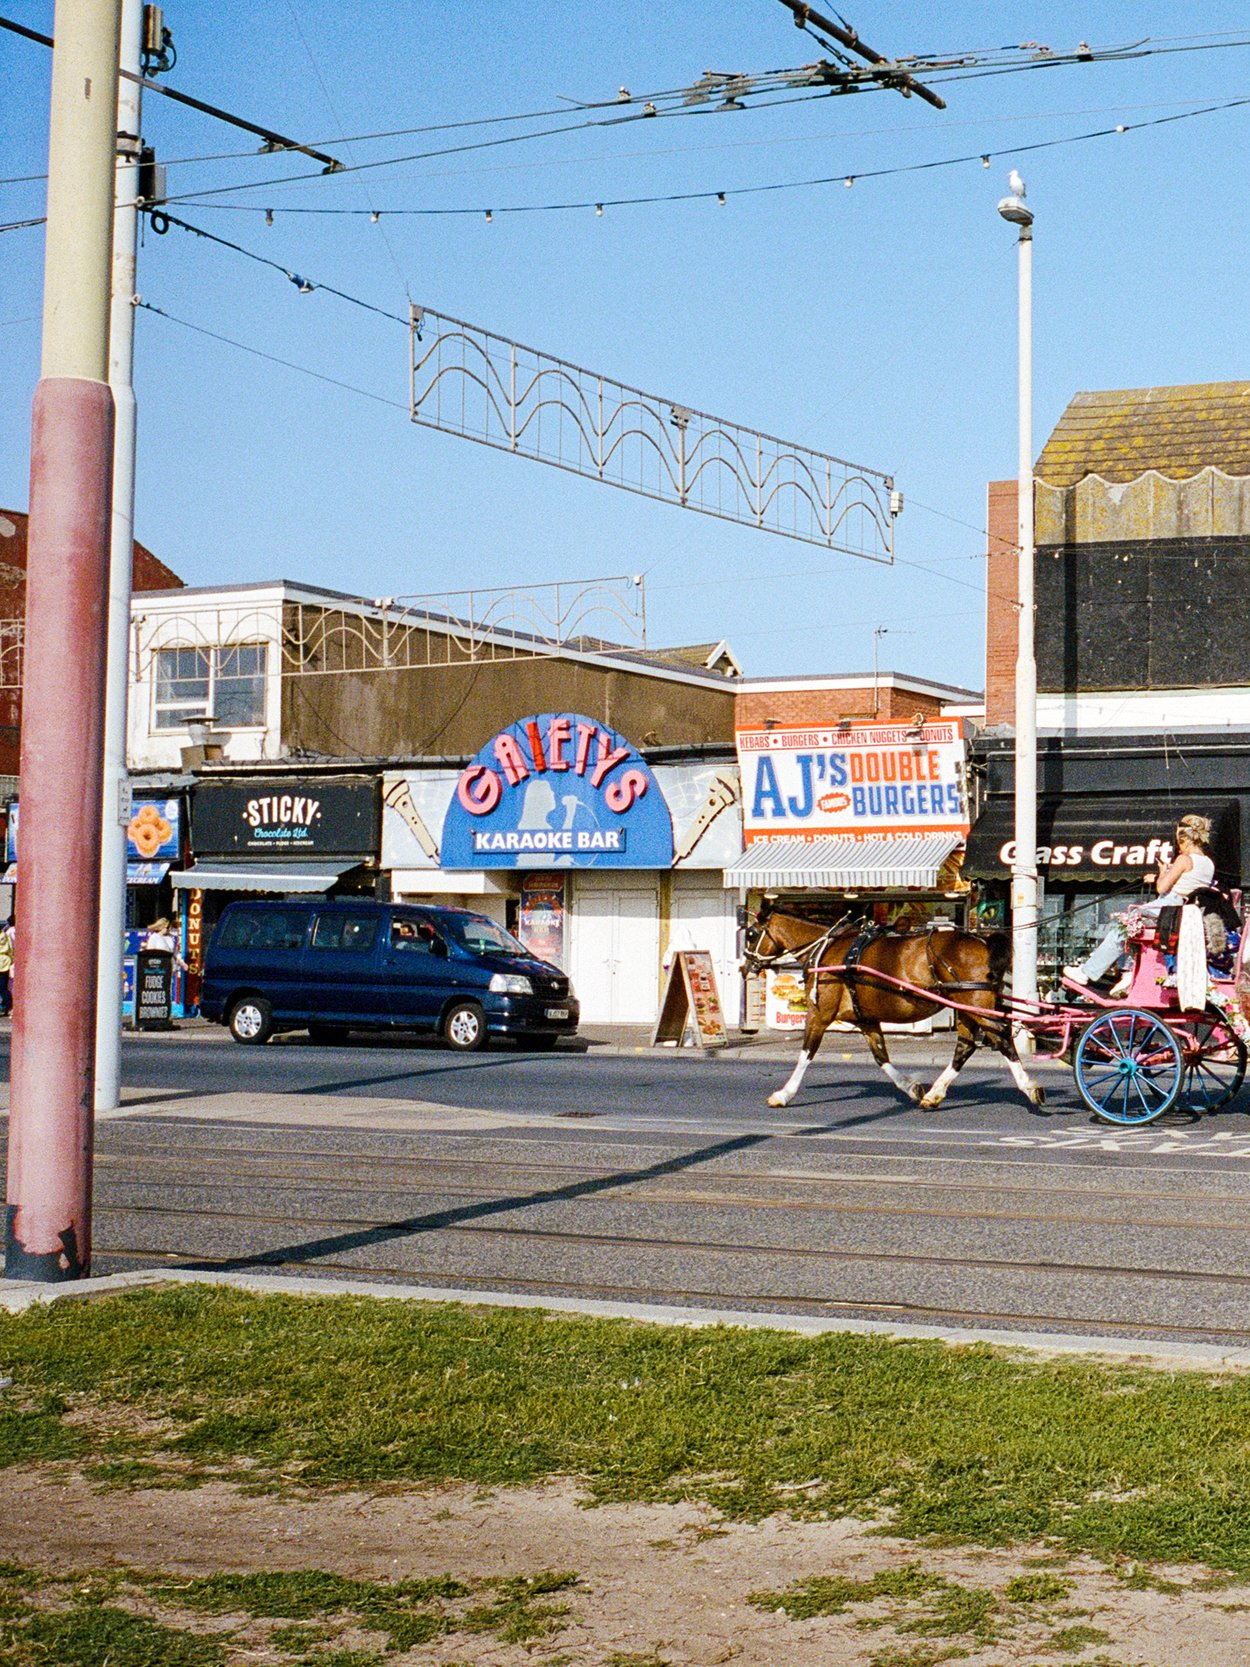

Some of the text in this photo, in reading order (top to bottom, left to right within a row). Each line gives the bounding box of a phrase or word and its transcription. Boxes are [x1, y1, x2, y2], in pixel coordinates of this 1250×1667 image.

[740, 728, 953, 749] KEBABS BURGERS CHICKEN NUGGETS DONUTS
[457, 718, 649, 814] GAIETYS
[849, 750, 940, 783] DOUBLE
[751, 753, 848, 818] AJ'S
[247, 795, 320, 827] STICKY
[851, 783, 960, 816] BURGERS
[253, 826, 292, 839] Chocolate
[475, 830, 620, 849] KARAOKE BAR
[753, 836, 769, 845] ICE
[769, 834, 805, 844] CREAM
[813, 833, 856, 843] DONUTS
[863, 832, 885, 842] HOT
[895, 831, 924, 841] COLD
[924, 830, 963, 840] DRINKS
[1000, 839, 1174, 866] Gass Craft
[145, 975, 164, 989] FUDGE
